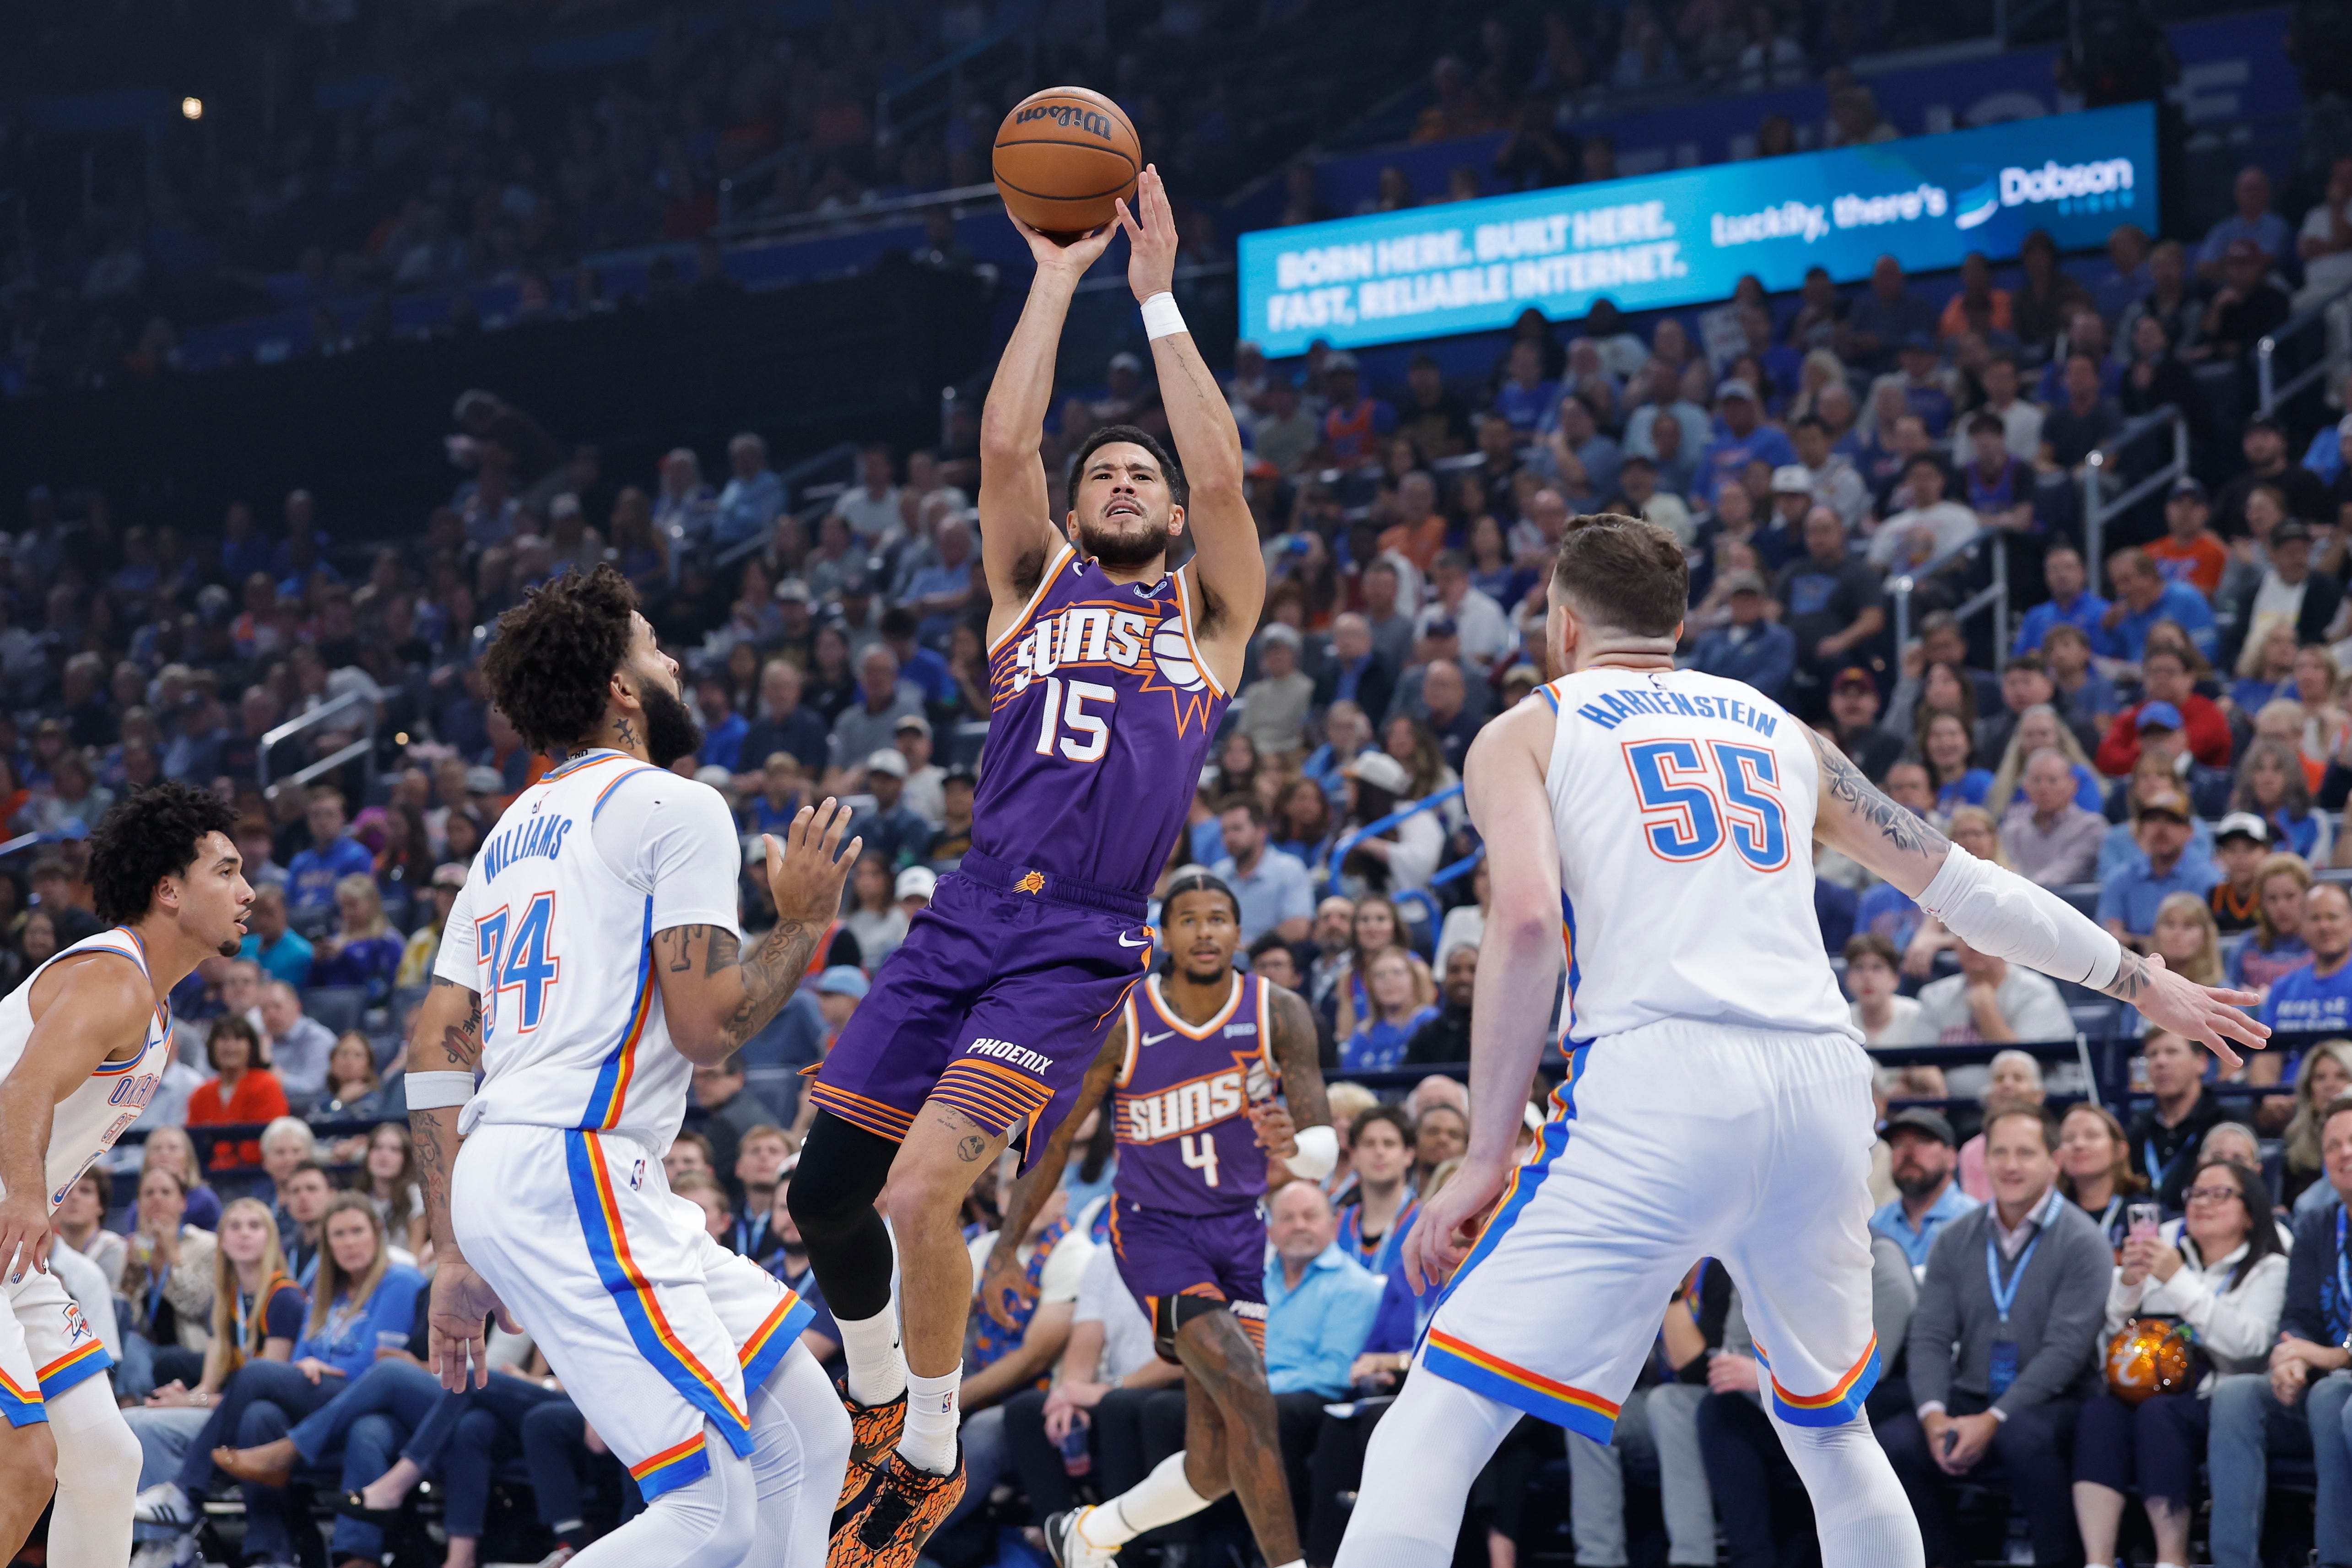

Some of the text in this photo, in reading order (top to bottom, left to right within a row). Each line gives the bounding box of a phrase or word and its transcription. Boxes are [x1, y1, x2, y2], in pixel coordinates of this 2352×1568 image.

[1016, 105, 1112, 141] Wilson
[1833, 182, 1948, 229] there's
[2000, 157, 2134, 207] Dobson
[1277, 200, 1676, 290] BORN HERE. BUILT HERE.
[1267, 239, 1688, 332] FAST, RELIABLE INTERNET.
[1014, 609, 1147, 693] SUNS
[1035, 676, 1116, 762] 15
[1577, 689, 1777, 738] HARTENSTEIN
[1621, 737, 1791, 873] 55
[484, 814, 572, 885] WILLIAMS
[475, 890, 560, 1049] 34
[966, 1038, 1054, 1076] PHOENIX
[1128, 1072, 1243, 1141] SUNS
[1181, 1132, 1219, 1187] 4
